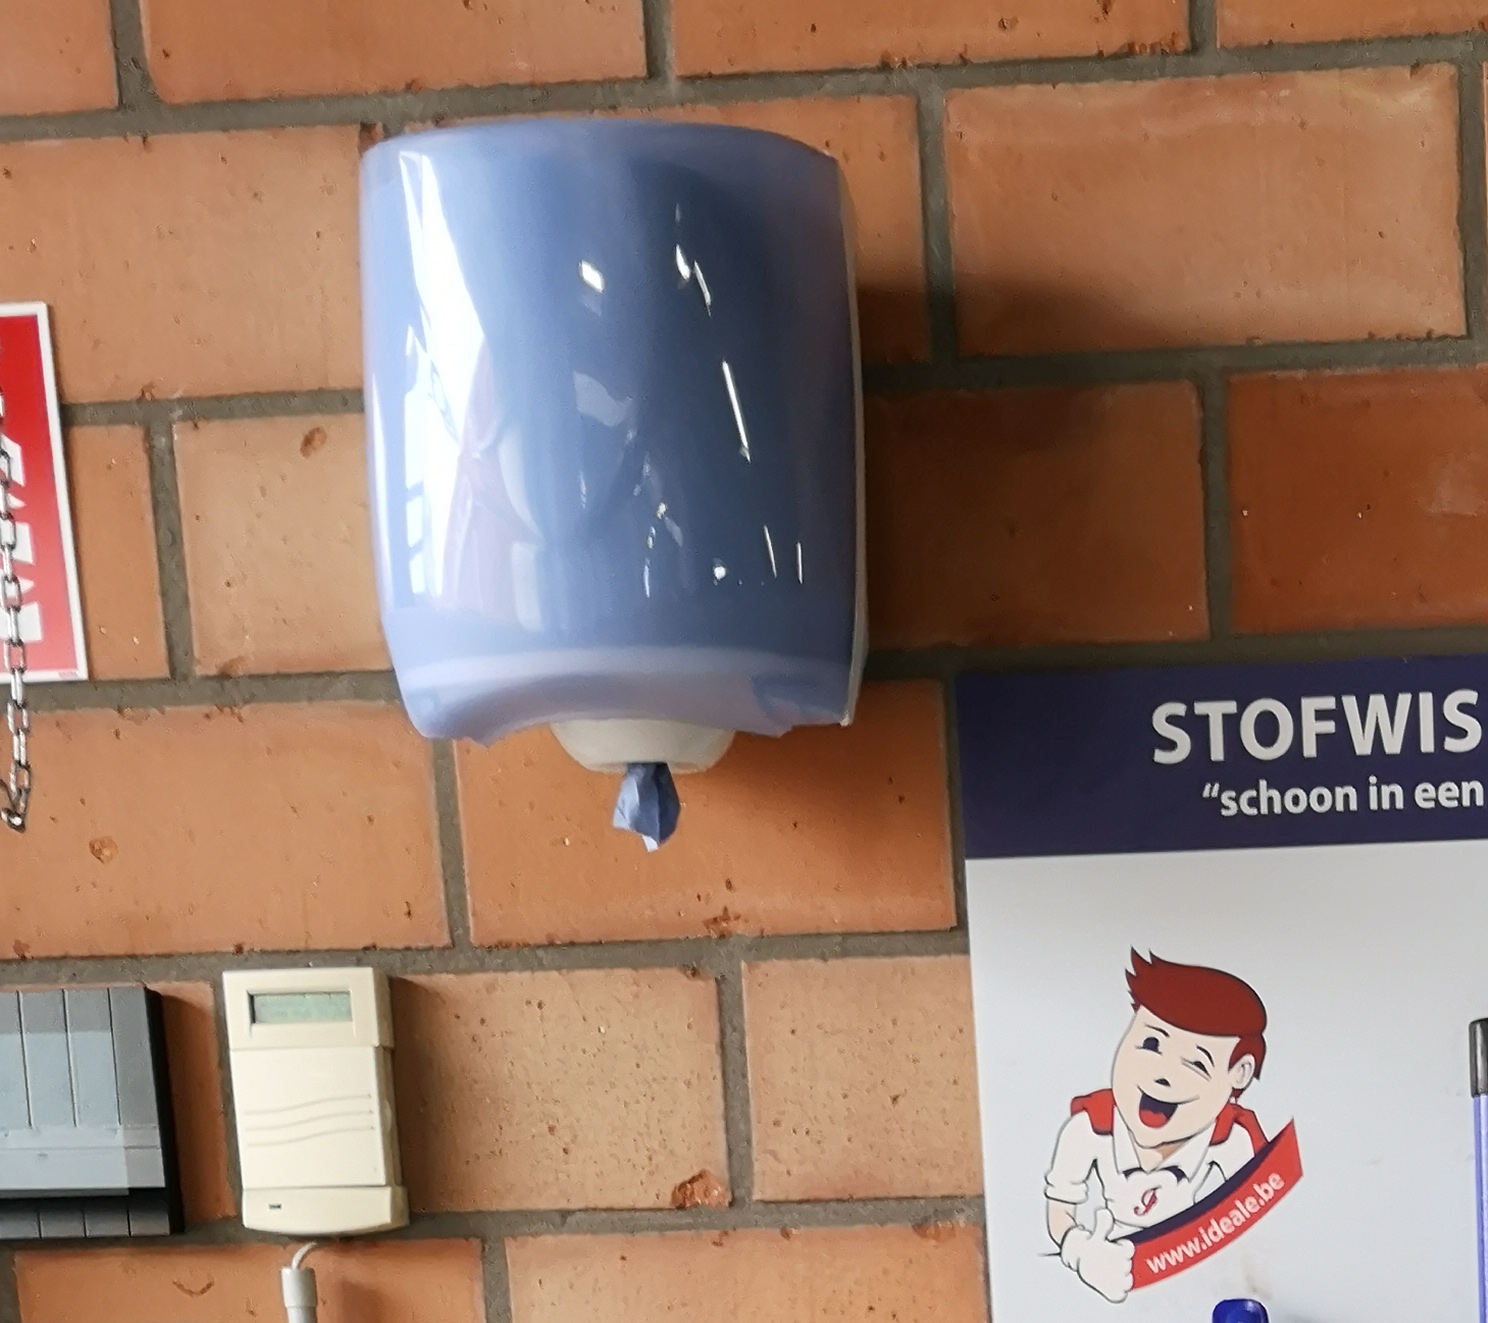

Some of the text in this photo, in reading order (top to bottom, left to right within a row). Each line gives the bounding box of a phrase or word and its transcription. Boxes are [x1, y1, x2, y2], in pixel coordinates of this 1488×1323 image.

[1152, 689, 1482, 764] STOFWIS
[1368, 775, 1404, 811] in
[1414, 780, 1485, 809] een
[1145, 1172, 1286, 1274] www.ideale.be
